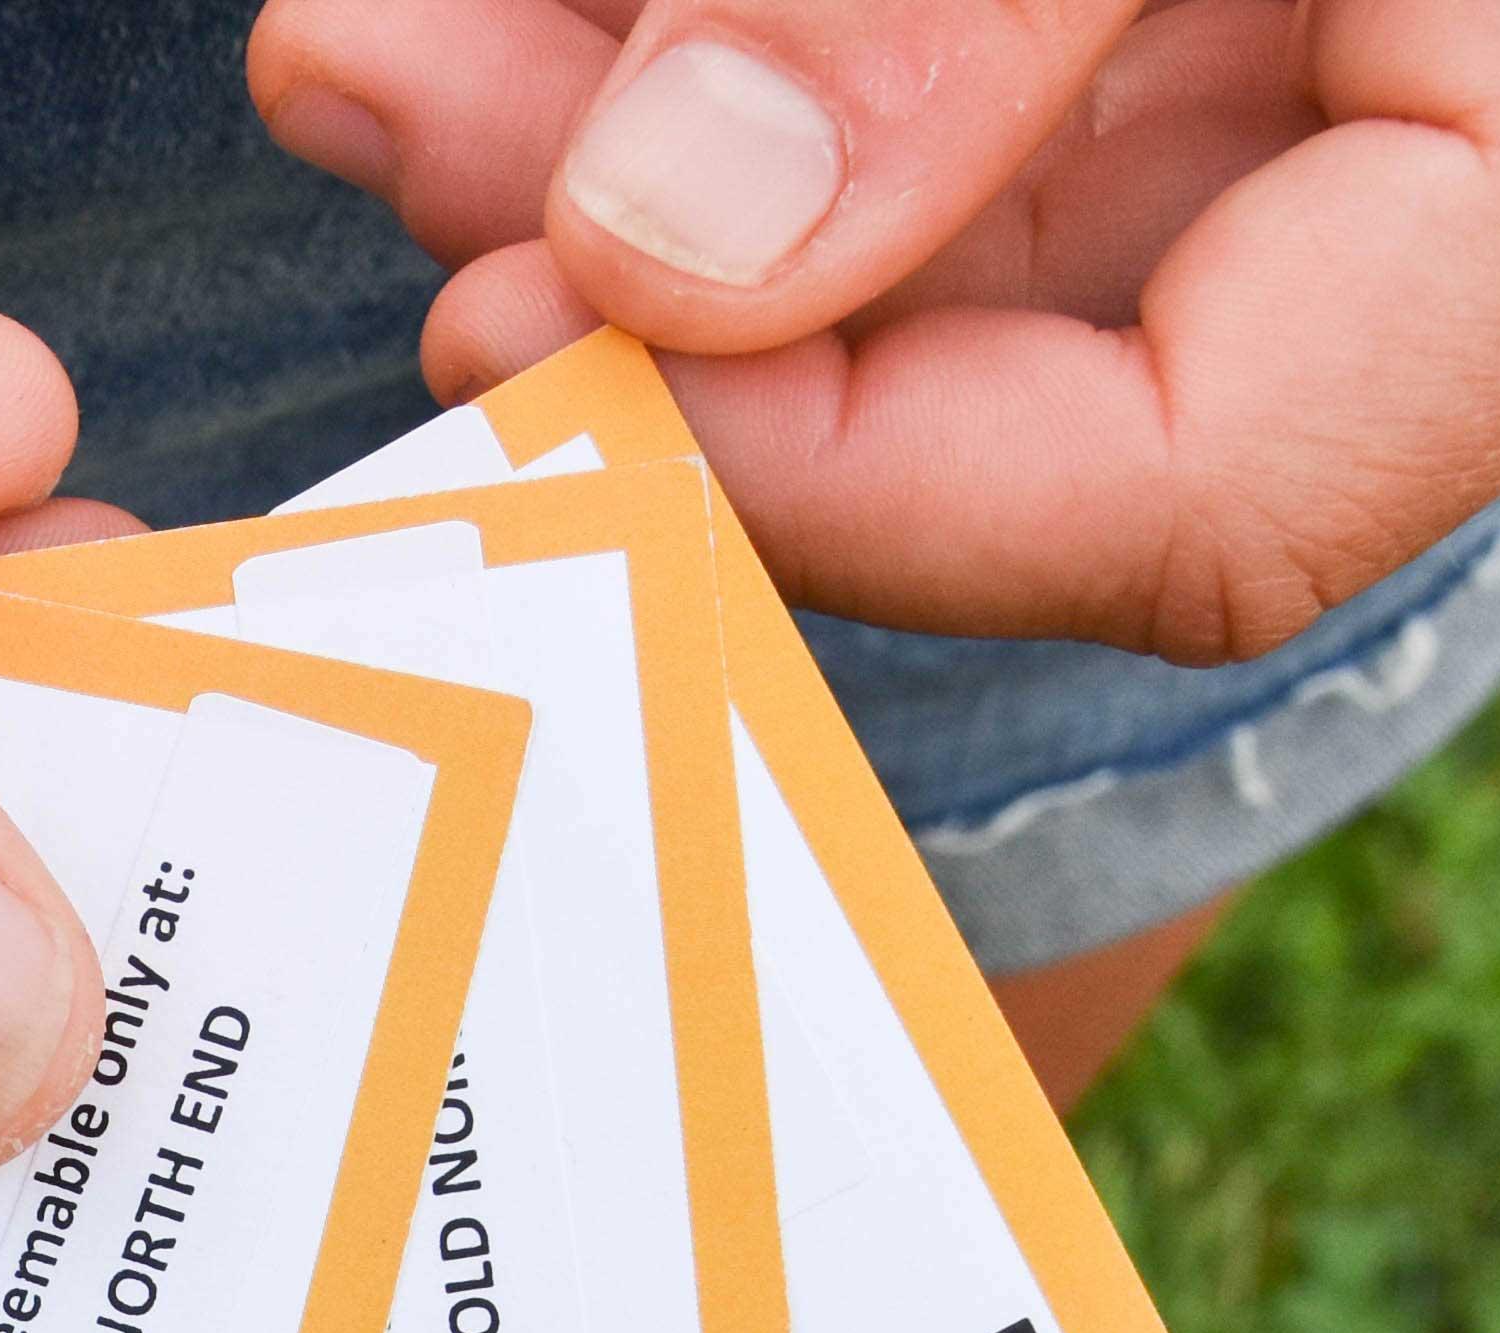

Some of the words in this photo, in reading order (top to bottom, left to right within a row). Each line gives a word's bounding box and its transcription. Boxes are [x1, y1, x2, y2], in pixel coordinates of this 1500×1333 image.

[91, 952, 172, 1087] only
[138, 861, 196, 943] at:
[169, 1005, 251, 1135] END
